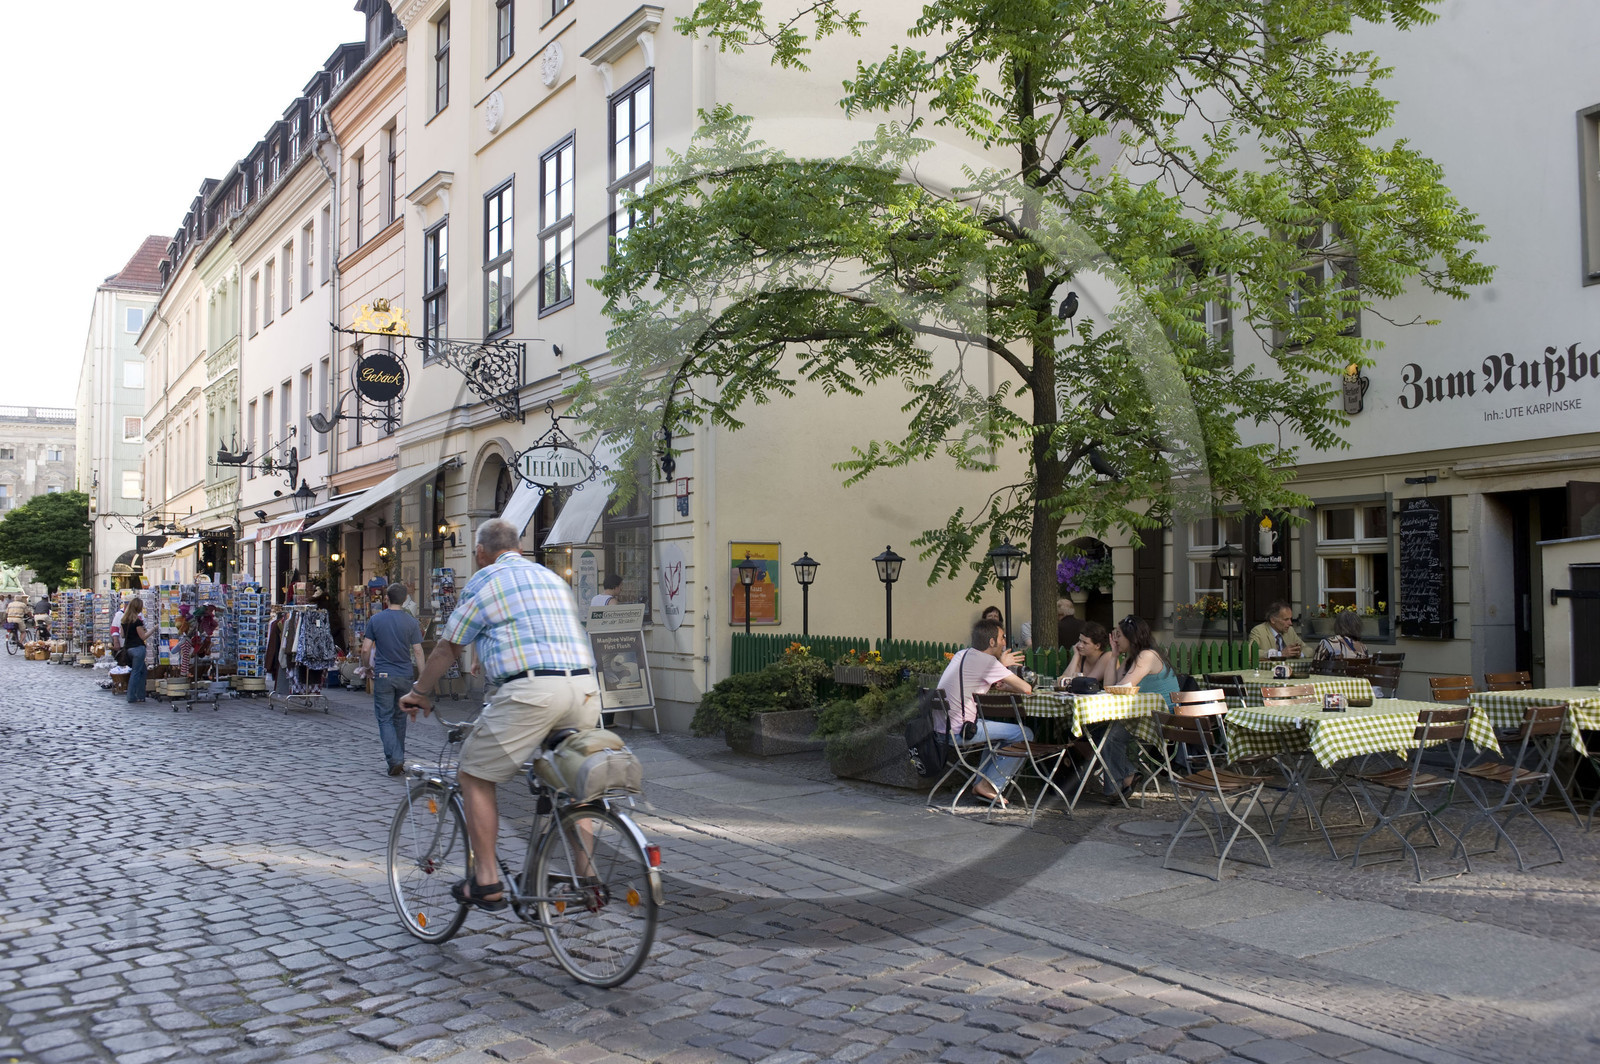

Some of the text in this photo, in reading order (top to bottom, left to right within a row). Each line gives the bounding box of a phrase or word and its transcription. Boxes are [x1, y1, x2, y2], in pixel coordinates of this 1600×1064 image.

[360, 367, 402, 386] Gebäck
[1397, 363, 1477, 410] Zum
[1505, 406, 1524, 419] UTE
[1525, 398, 1583, 417] KARPINSKE
[523, 455, 588, 479] TEELADEN
